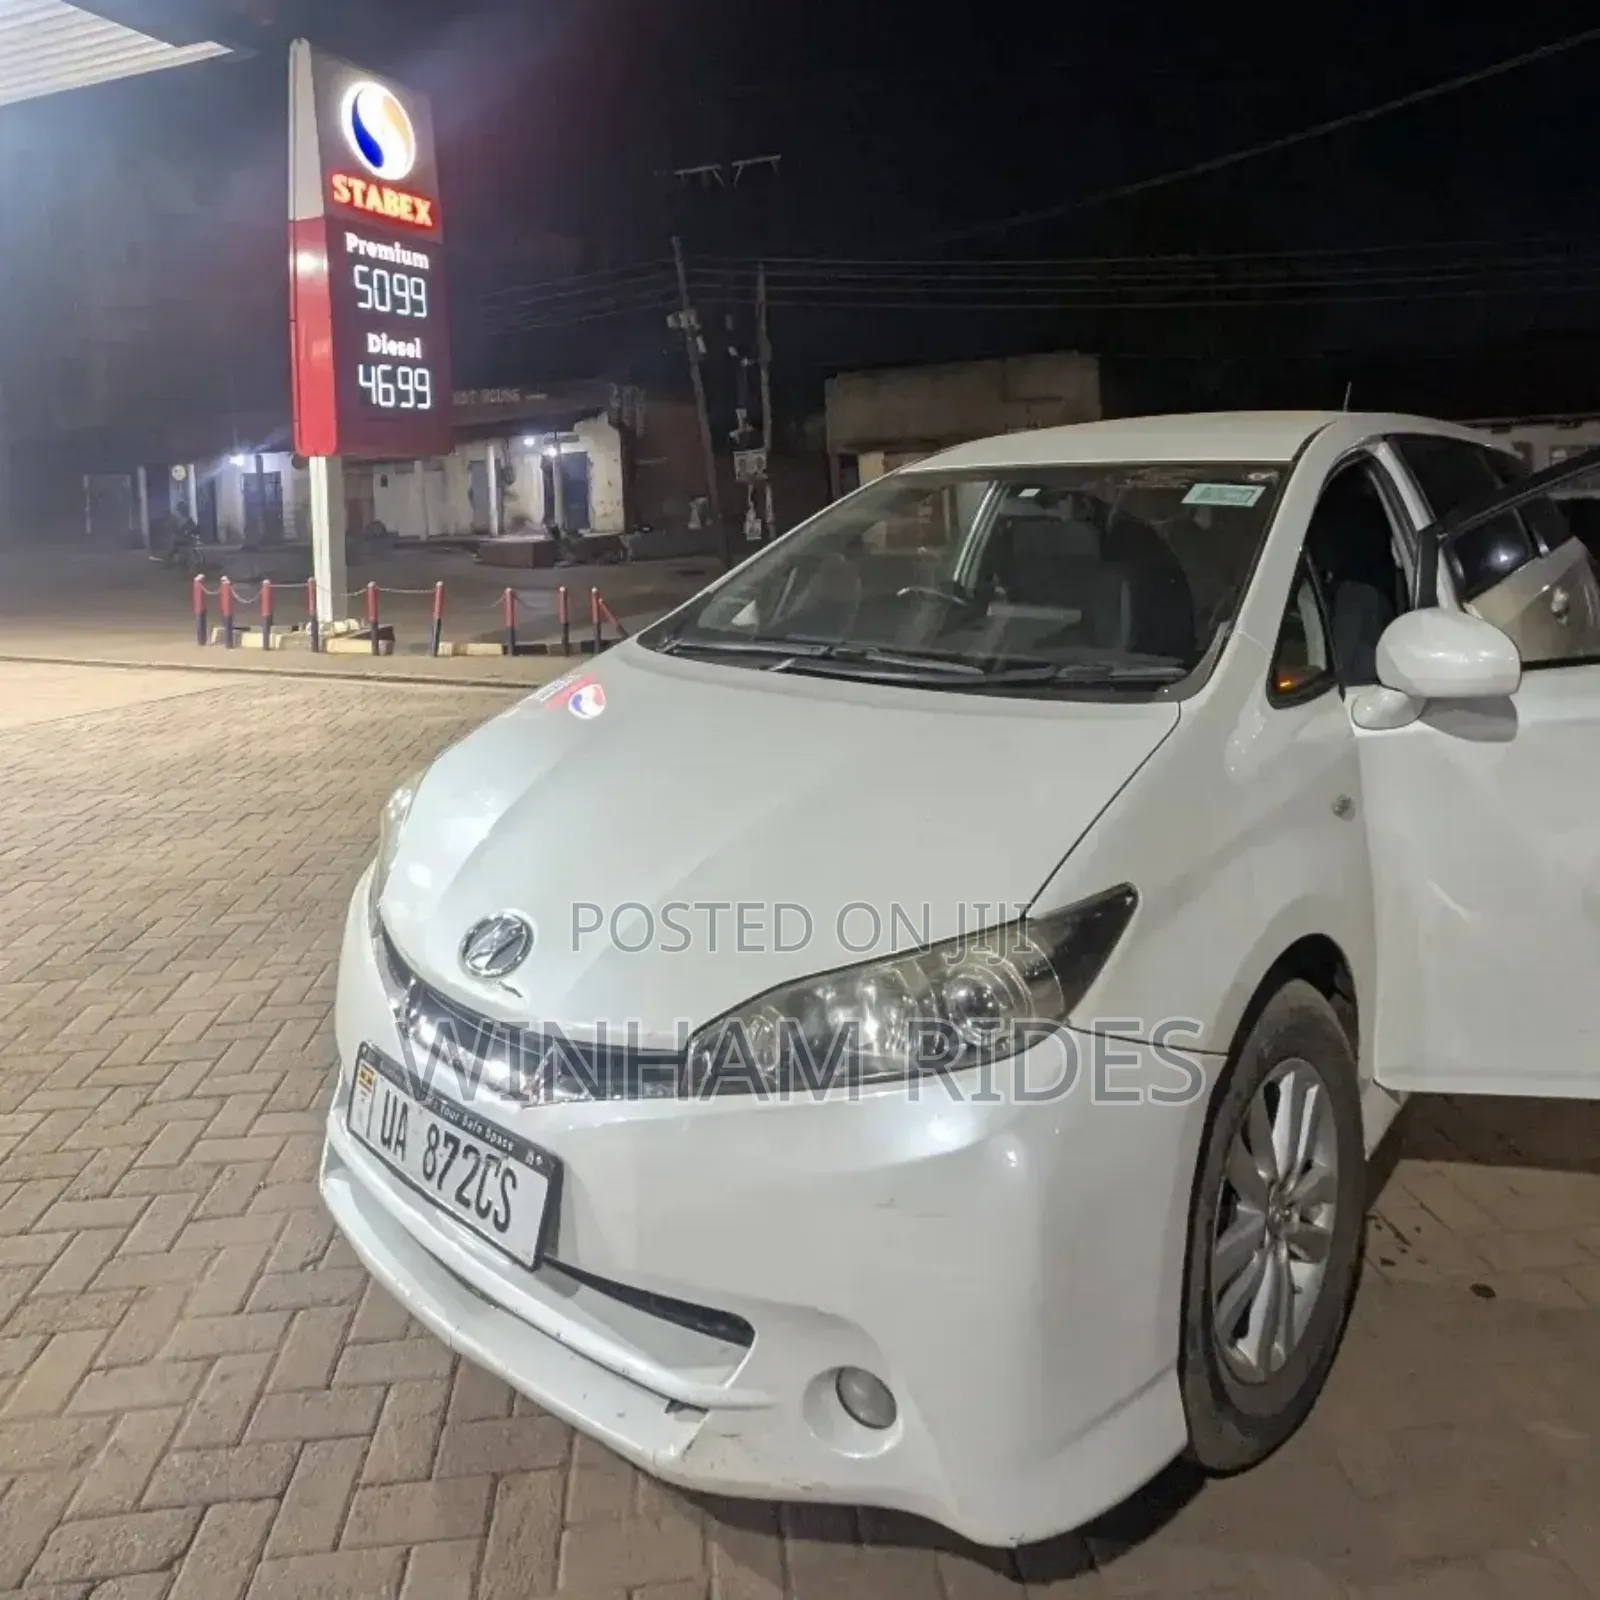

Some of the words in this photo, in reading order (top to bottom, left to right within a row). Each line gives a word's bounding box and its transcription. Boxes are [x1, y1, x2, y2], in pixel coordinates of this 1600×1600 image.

[332, 174, 433, 227] STABEX
[344, 232, 429, 269] Premium
[354, 265, 427, 318] 5099
[367, 332, 422, 359] Diesel
[358, 363, 431, 410] 4699
[380, 1089, 409, 1162] UA
[422, 1123, 518, 1234] 872CS
